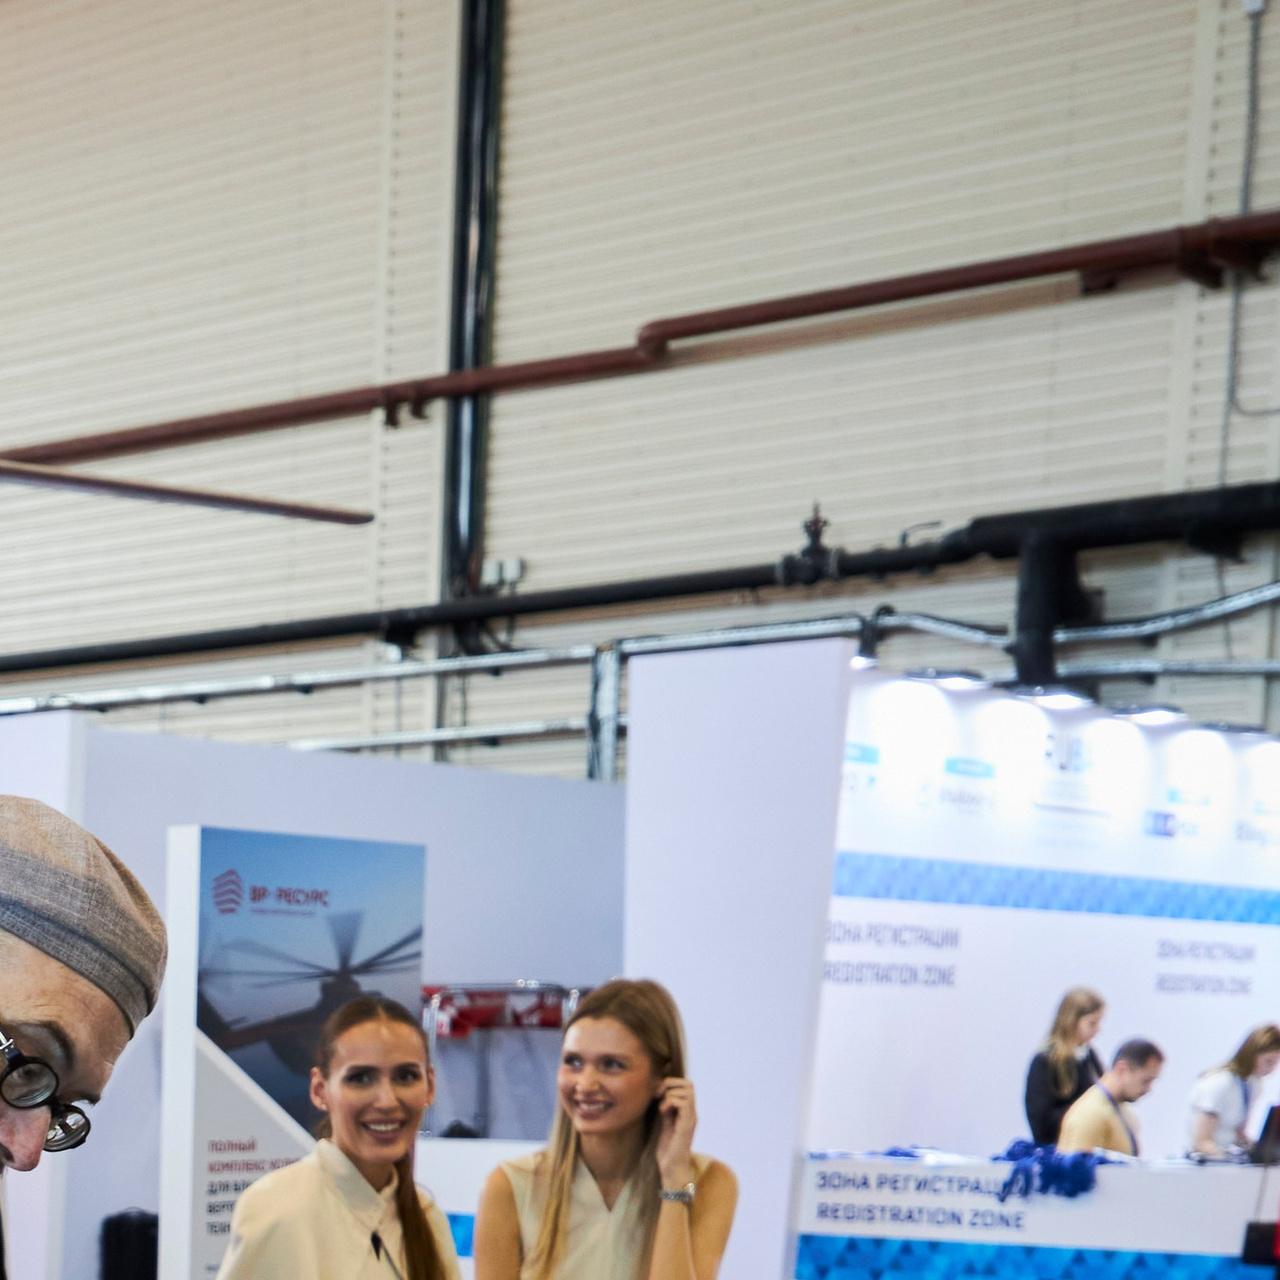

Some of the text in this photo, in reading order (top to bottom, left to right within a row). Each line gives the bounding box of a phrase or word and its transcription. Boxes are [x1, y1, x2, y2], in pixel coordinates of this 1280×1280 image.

[816, 1171, 871, 1190] ЗОНА
[817, 1202, 1025, 1229] REGISTRATION ZONE
